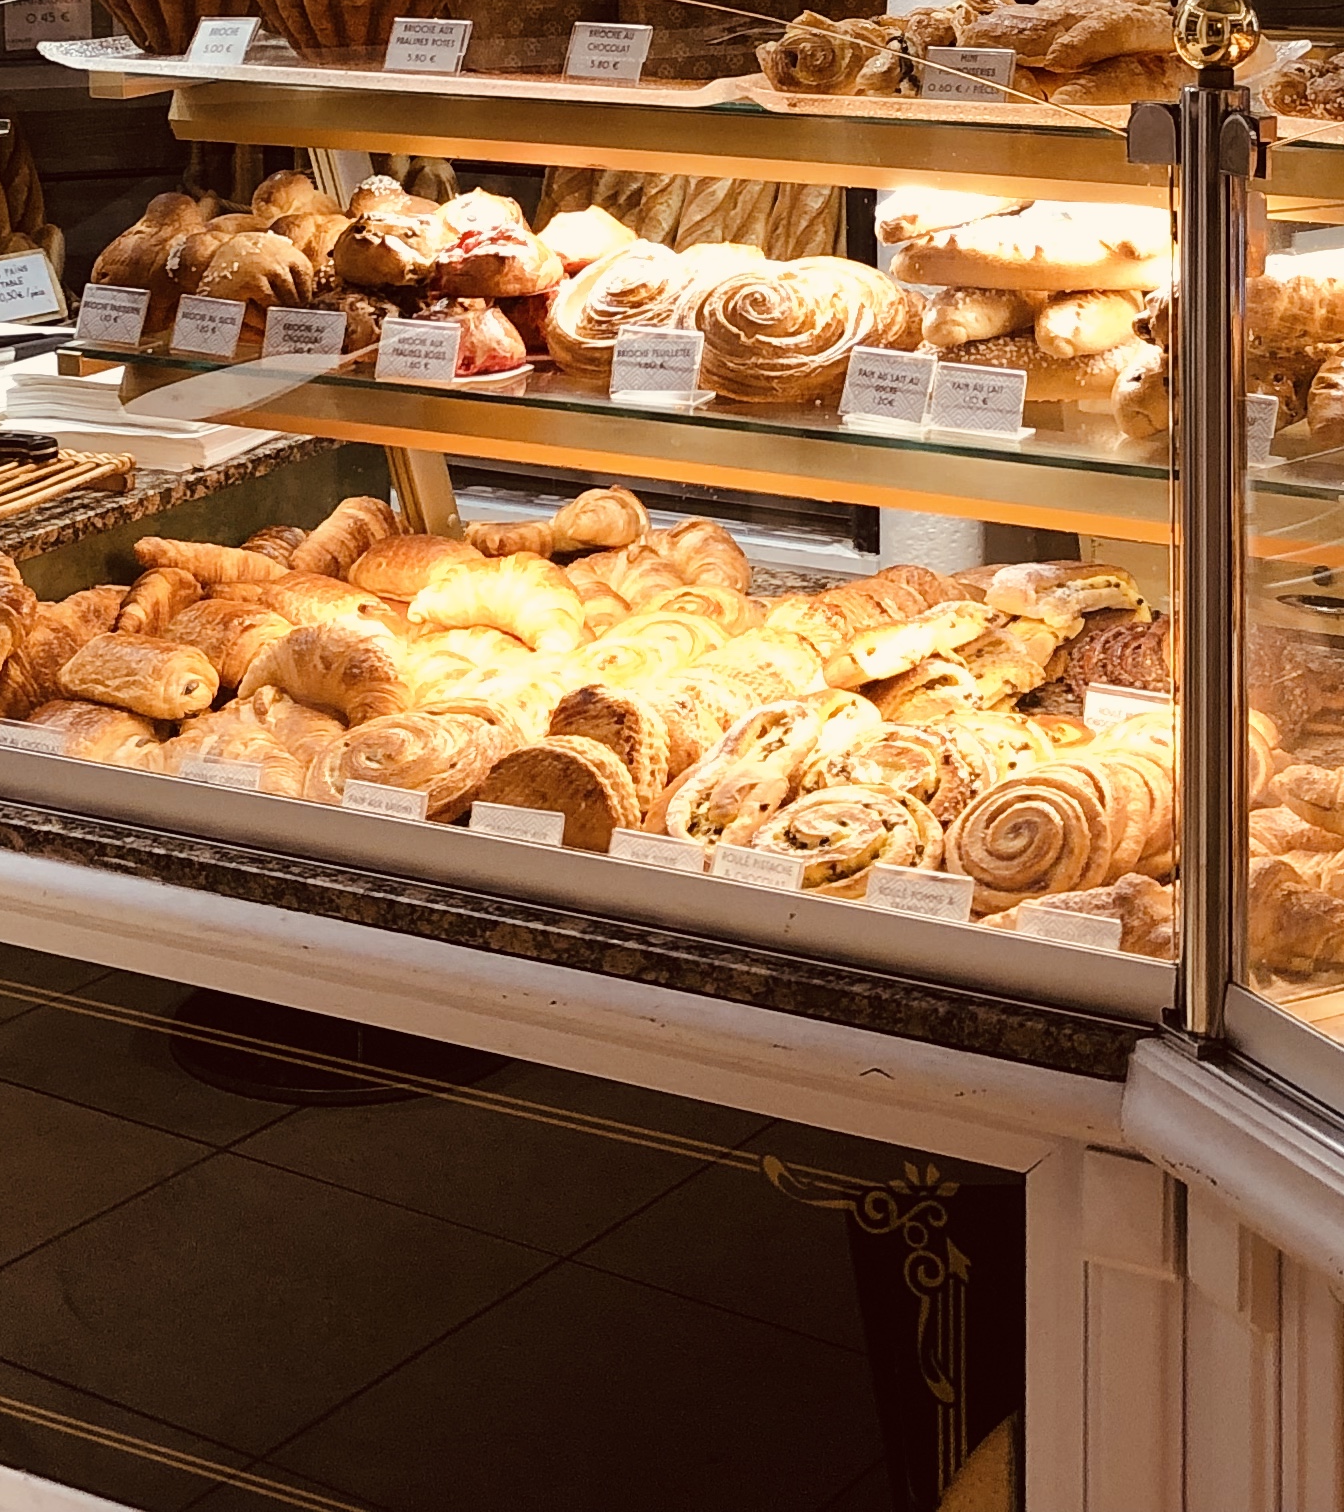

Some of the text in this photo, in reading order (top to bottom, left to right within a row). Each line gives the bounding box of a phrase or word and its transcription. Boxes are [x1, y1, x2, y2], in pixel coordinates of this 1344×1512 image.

[403, 24, 455, 34] BRIOCHE AUX
[589, 29, 635, 40] BRIOCHE AU
[396, 36, 429, 46] PRALINES
[587, 42, 630, 53] CHOCOLAT
[4, 265, 29, 277] PAINS
[1, 277, 24, 289] TABLE
